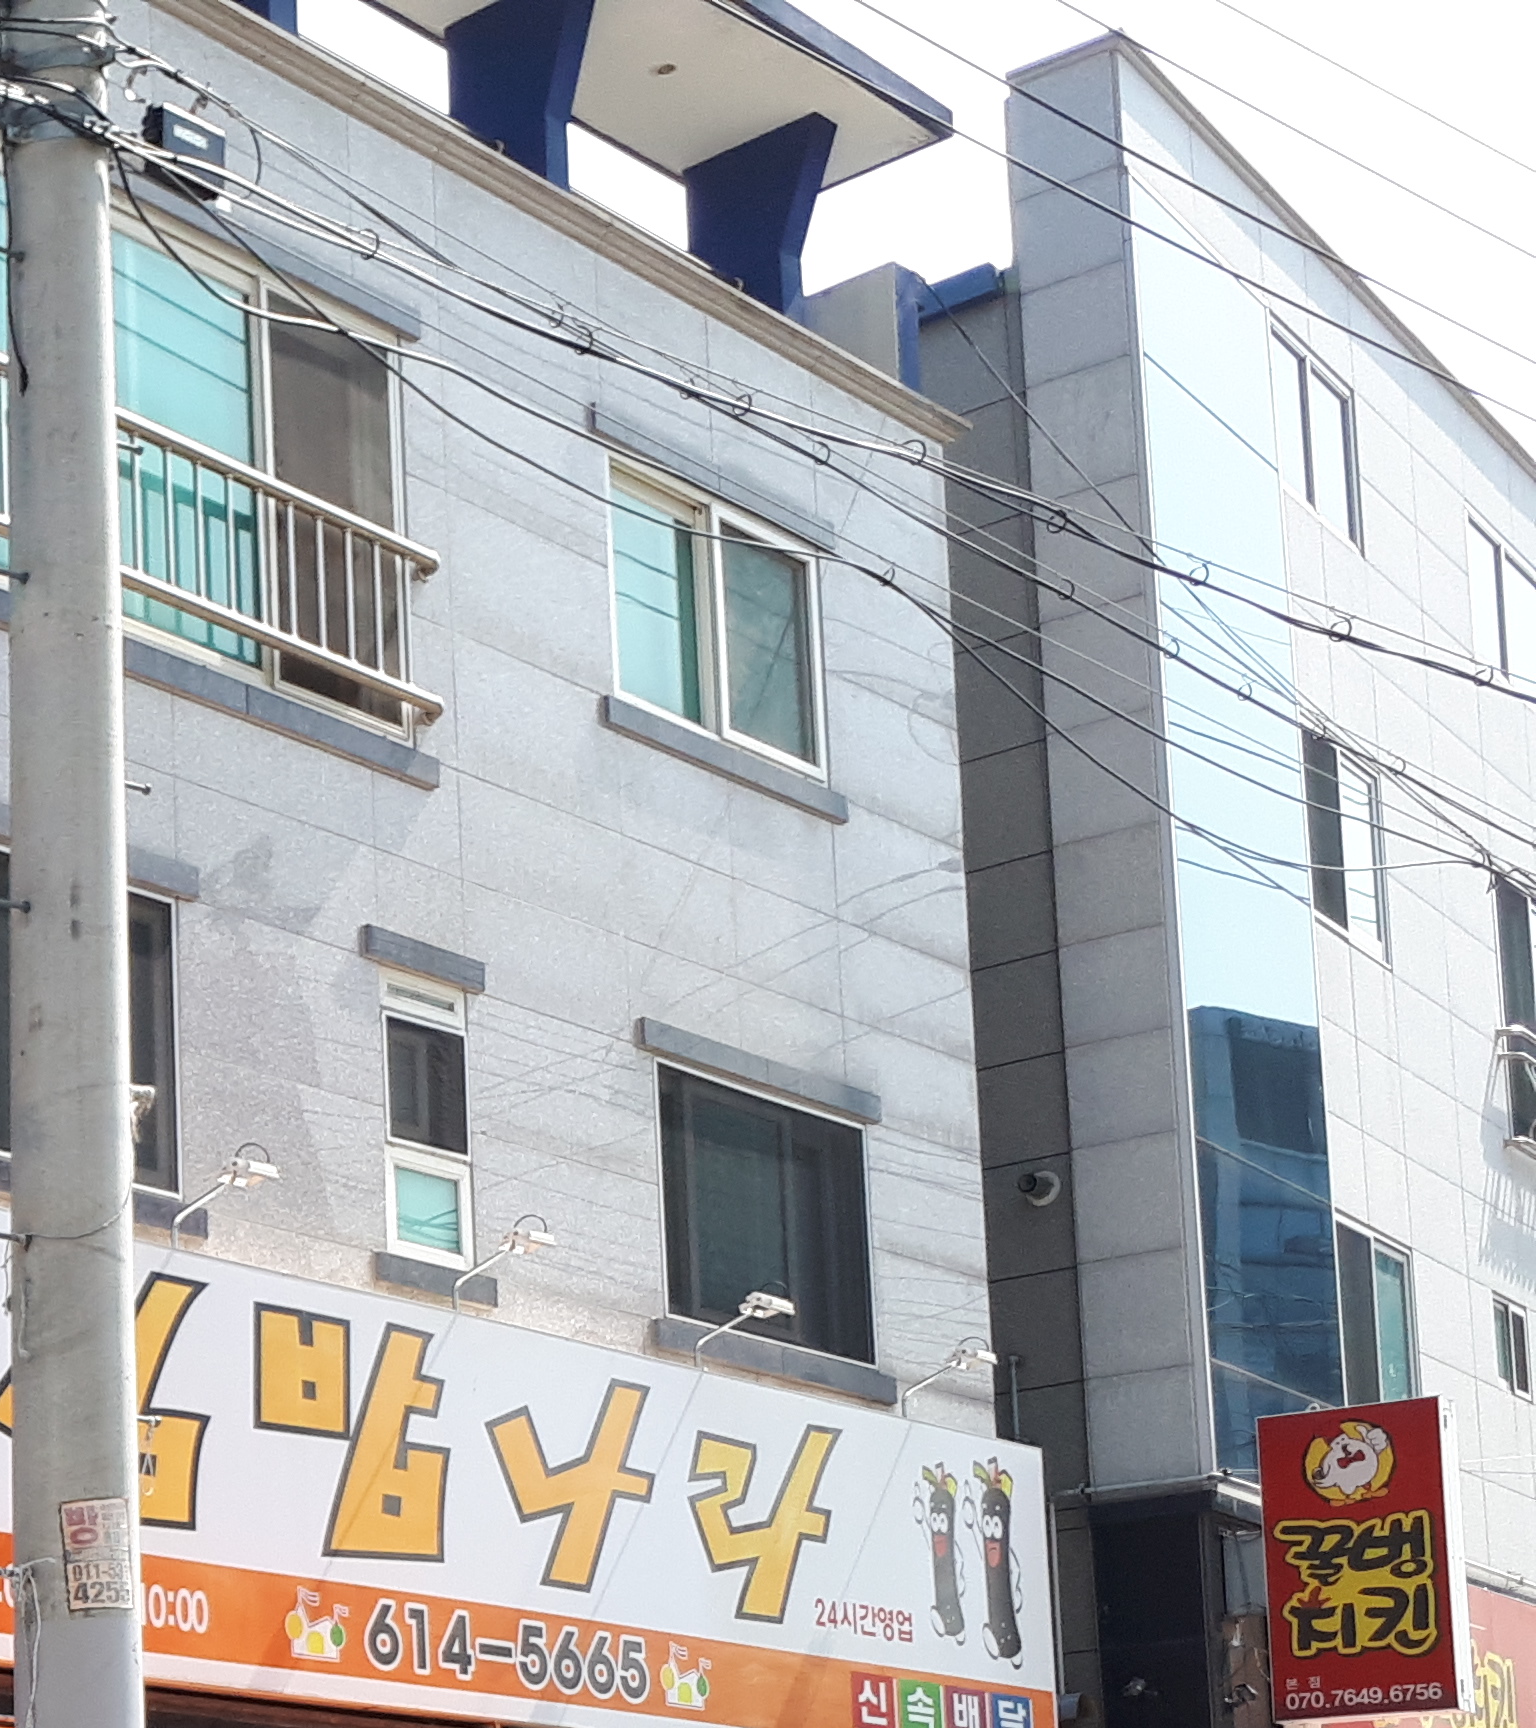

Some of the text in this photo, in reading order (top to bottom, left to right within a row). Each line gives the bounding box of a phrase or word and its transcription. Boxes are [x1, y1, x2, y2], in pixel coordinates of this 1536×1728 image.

[814, 1598, 914, 1643] 24시간영업
[364, 1597, 651, 1706] 614-5665
[1285, 1682, 1443, 1711] 070.7649.6756
